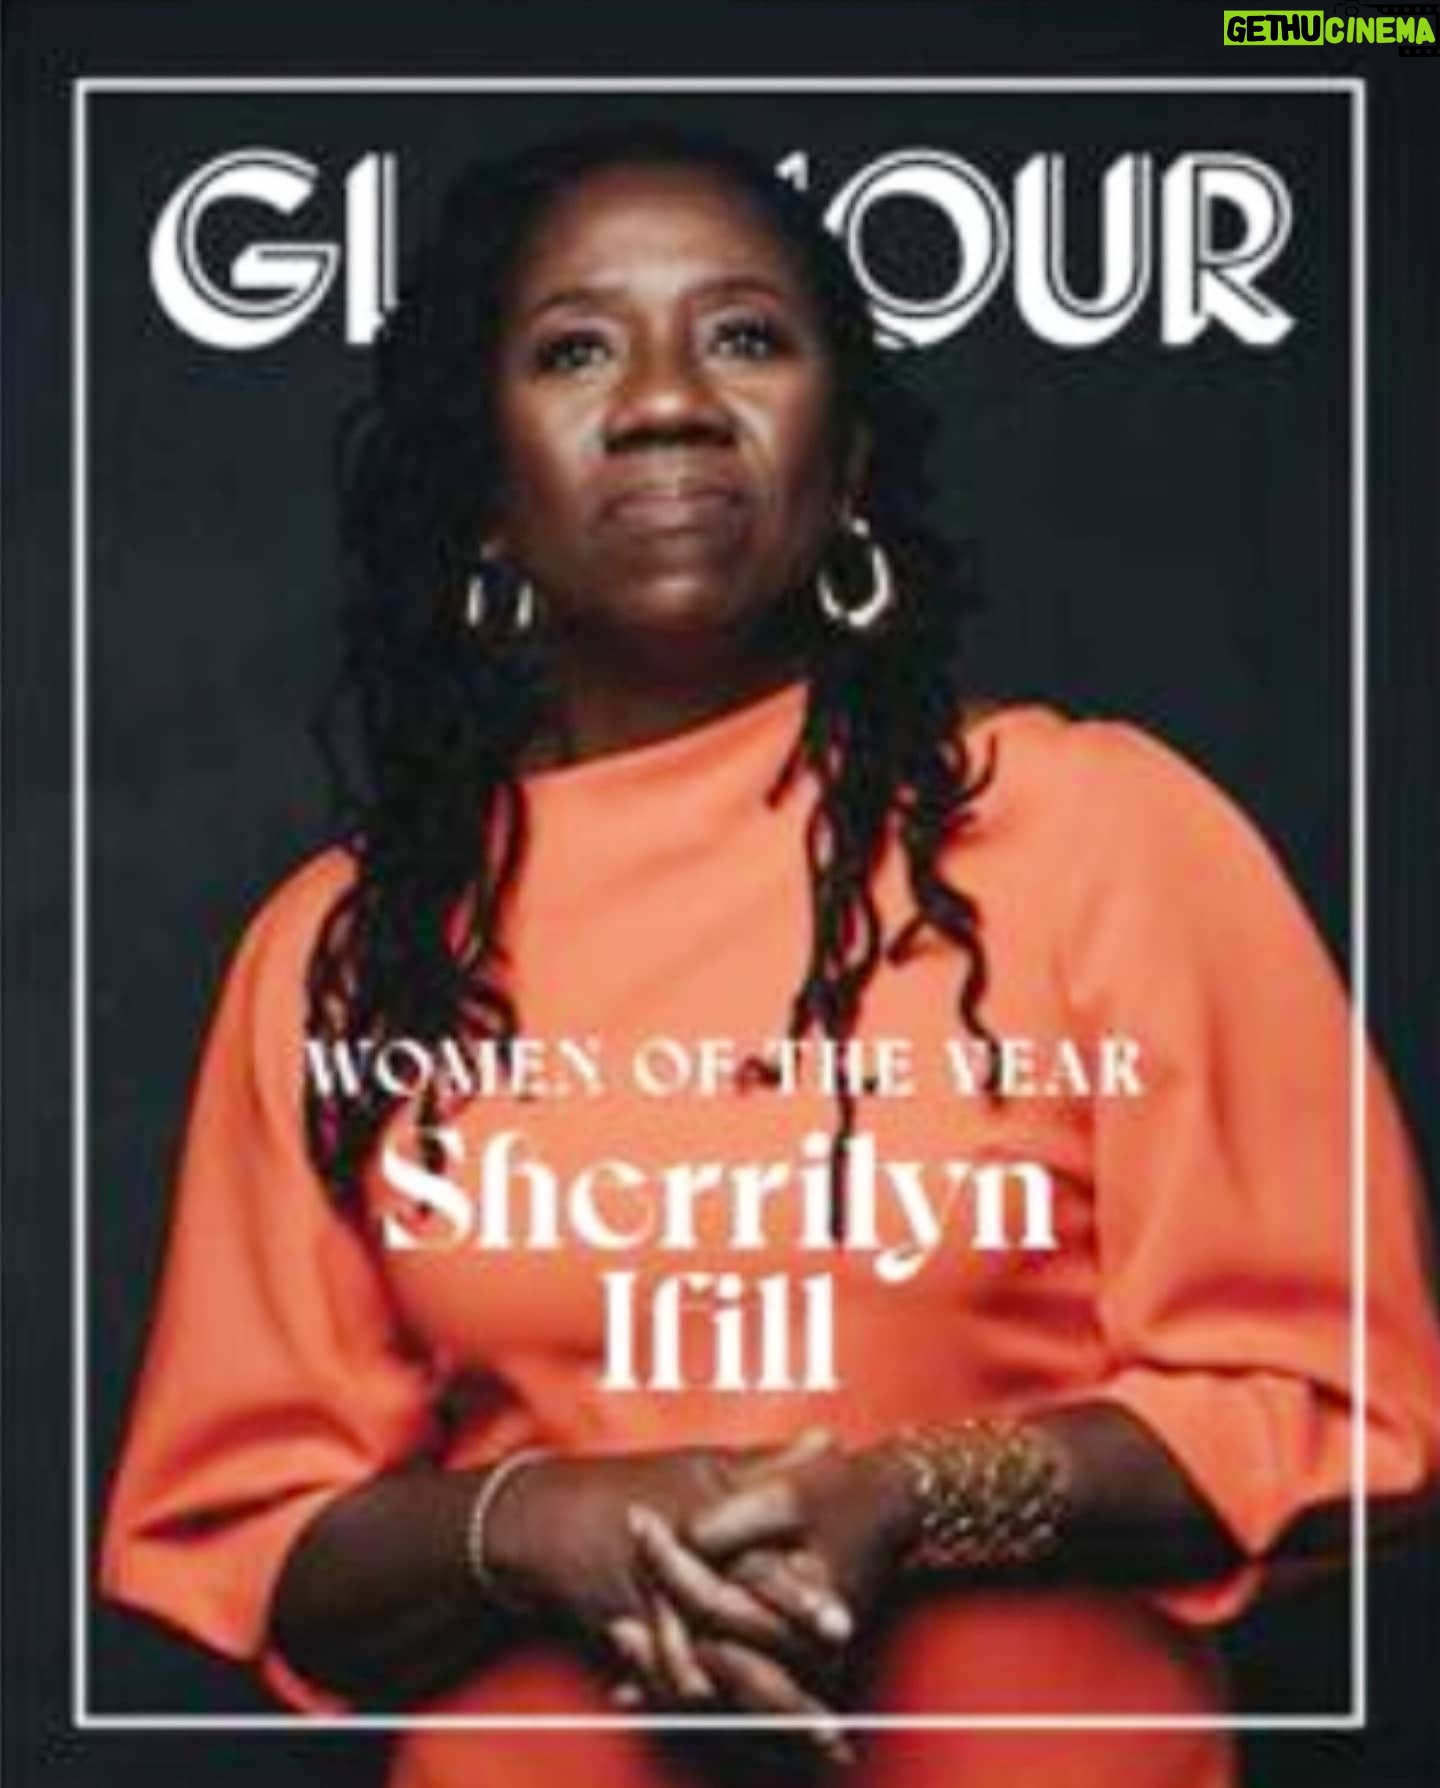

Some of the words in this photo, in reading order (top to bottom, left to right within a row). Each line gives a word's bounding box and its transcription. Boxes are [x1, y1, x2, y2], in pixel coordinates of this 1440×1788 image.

[149, 147, 1296, 348] GLOUR
[305, 1038, 602, 1098] WOMEN
[633, 1038, 738, 1098] OF
[749, 1038, 914, 1098] THE
[945, 1038, 1143, 1098] YEAR
[379, 1127, 1058, 1283] Sherrilyn
[599, 1271, 839, 1393] Ifill
